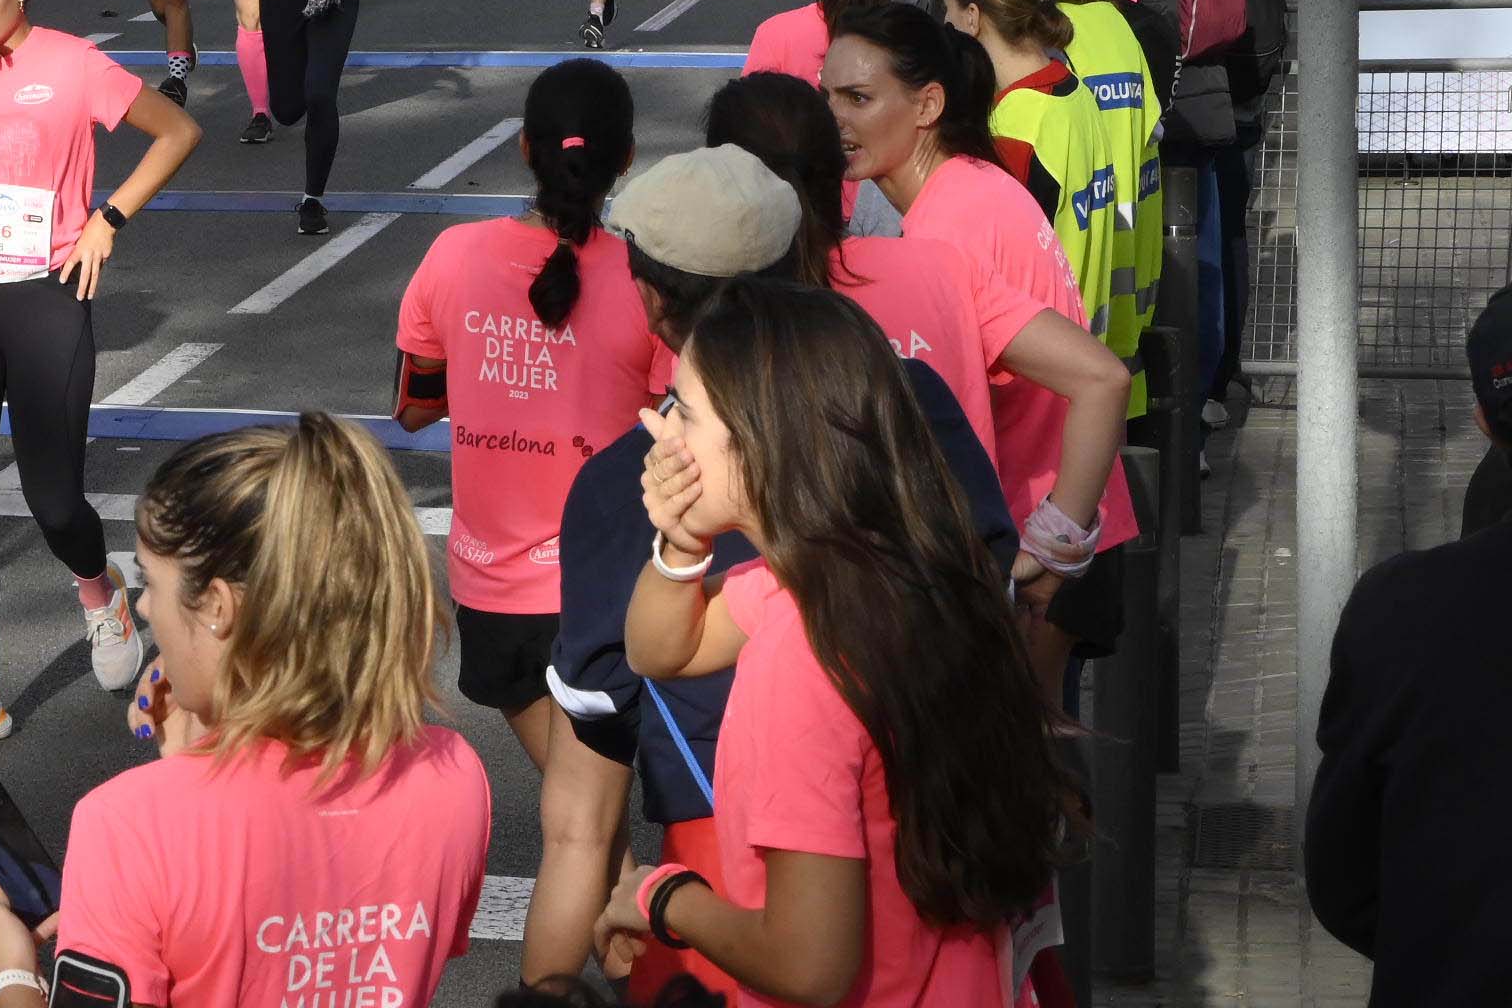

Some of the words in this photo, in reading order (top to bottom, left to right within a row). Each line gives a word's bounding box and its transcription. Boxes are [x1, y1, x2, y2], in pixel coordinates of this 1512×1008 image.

[464, 310, 577, 347] CARRERA
[485, 338, 514, 362] DE
[525, 341, 554, 368] LA
[478, 359, 558, 391] MUJER
[508, 389, 529, 400] 2023
[455, 425, 556, 457] Barcelona
[257, 900, 431, 955] CARRERA
[288, 952, 336, 992] DE
[348, 943, 398, 984] LA
